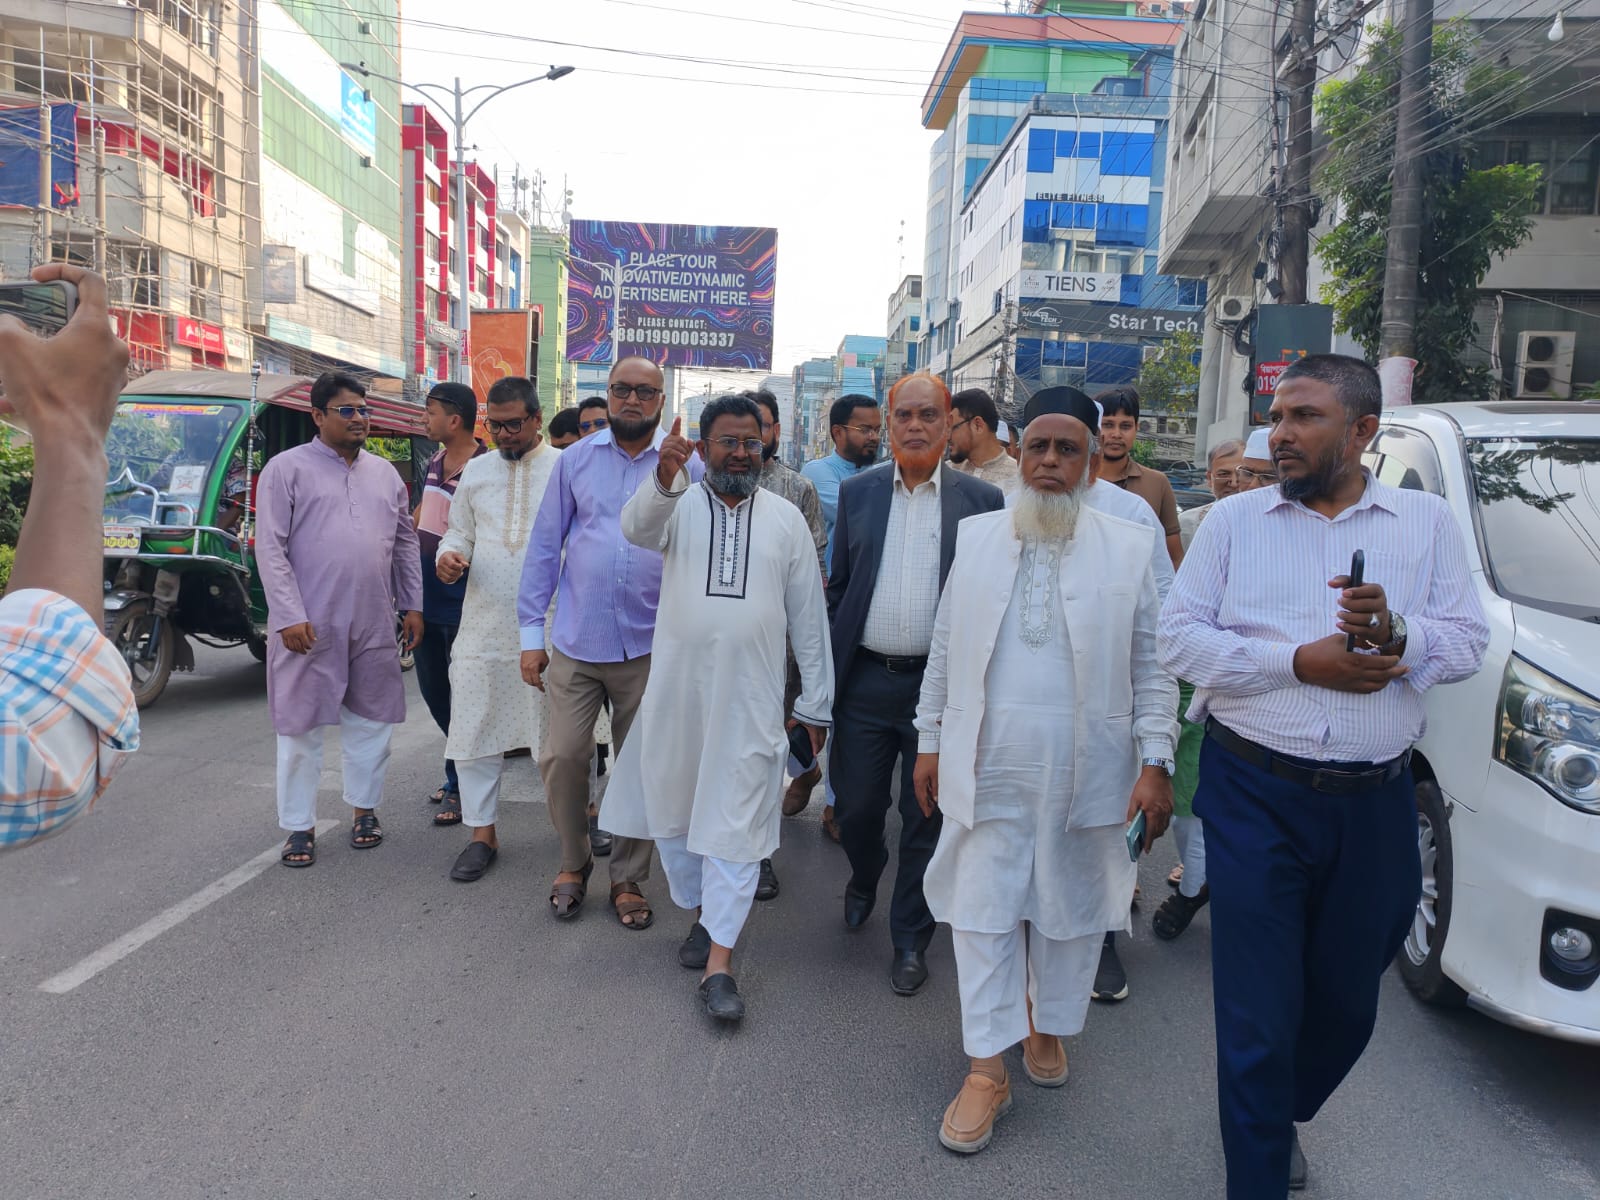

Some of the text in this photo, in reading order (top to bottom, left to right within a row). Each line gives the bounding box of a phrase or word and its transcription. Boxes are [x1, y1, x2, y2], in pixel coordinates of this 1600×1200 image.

[1067, 193, 1104, 203] FITNESS
[630, 252, 717, 269] PLACE YOUR
[600, 268, 745, 288] INOVATIVE/DYNAMIC
[1045, 275, 1096, 293] TIENS
[711, 291, 751, 305] HERE.
[637, 317, 708, 330] PLEASE CONTACT:
[1109, 313, 1198, 332] Star Tech
